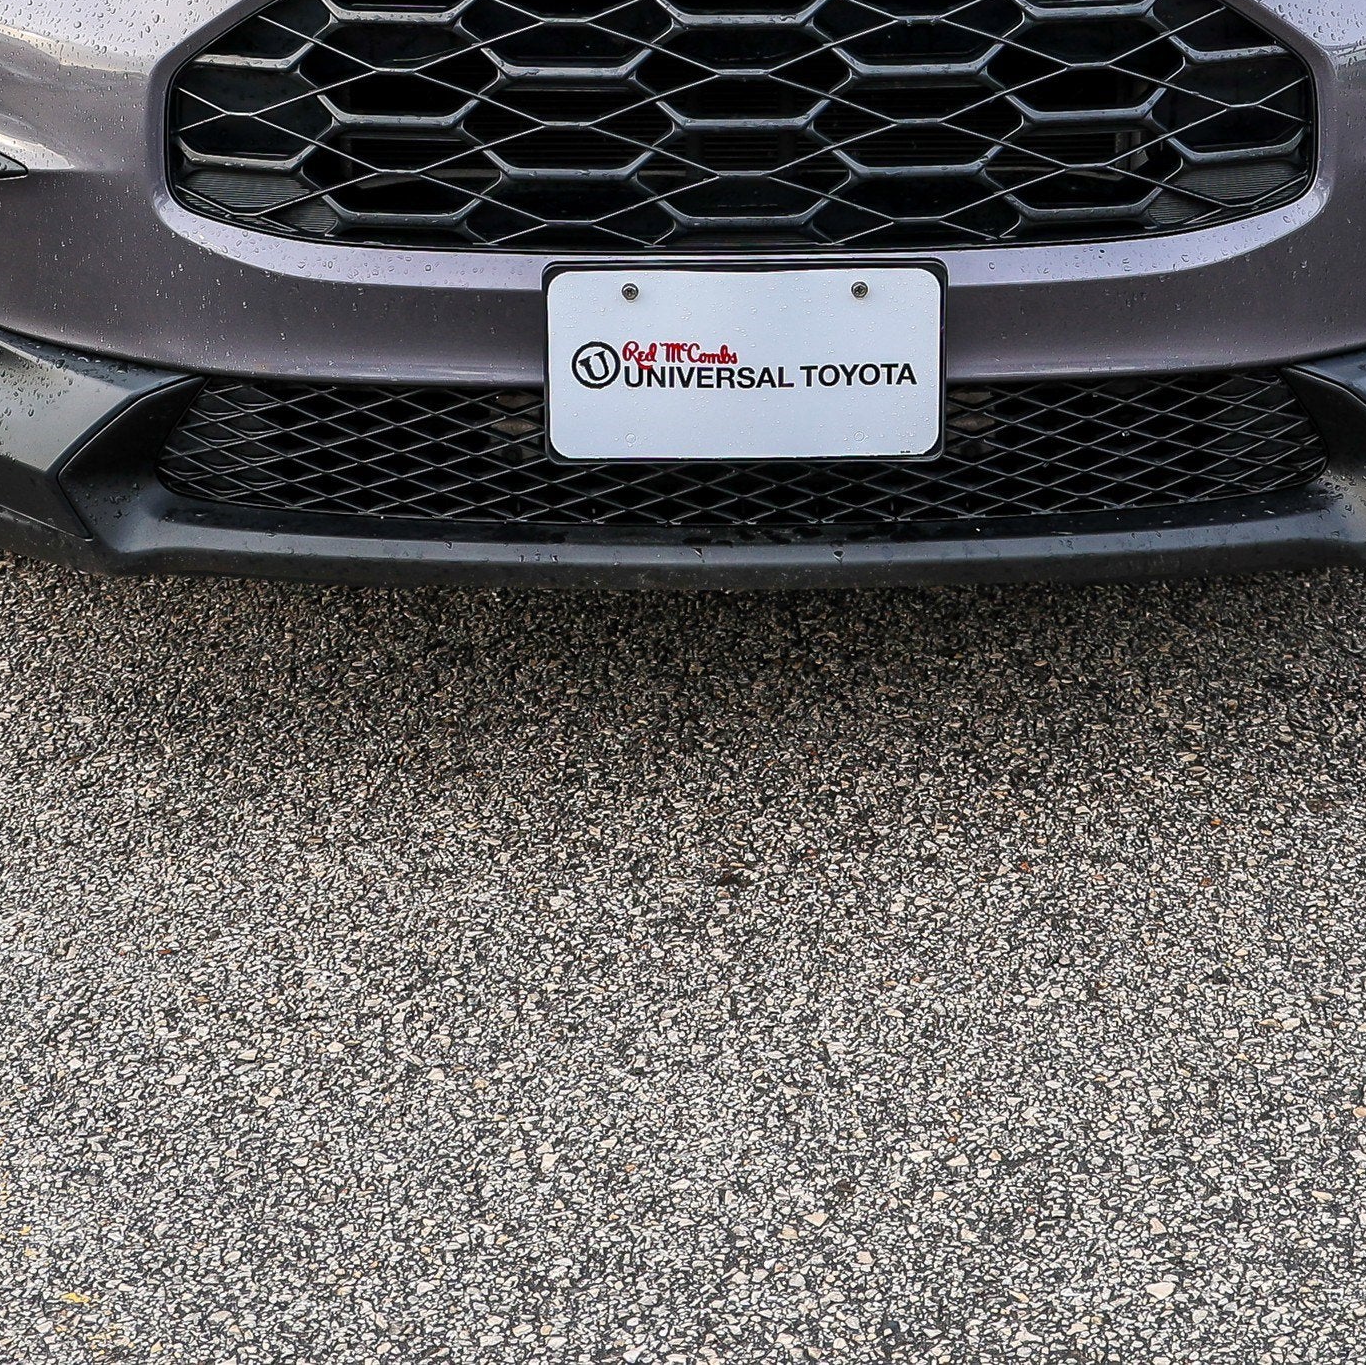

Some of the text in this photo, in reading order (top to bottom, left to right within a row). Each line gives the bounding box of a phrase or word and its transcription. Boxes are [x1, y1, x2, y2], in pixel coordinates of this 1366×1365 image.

[622, 340, 738, 370] Red McCombs
[624, 362, 917, 389] UNIVERSAL TOYOTA
